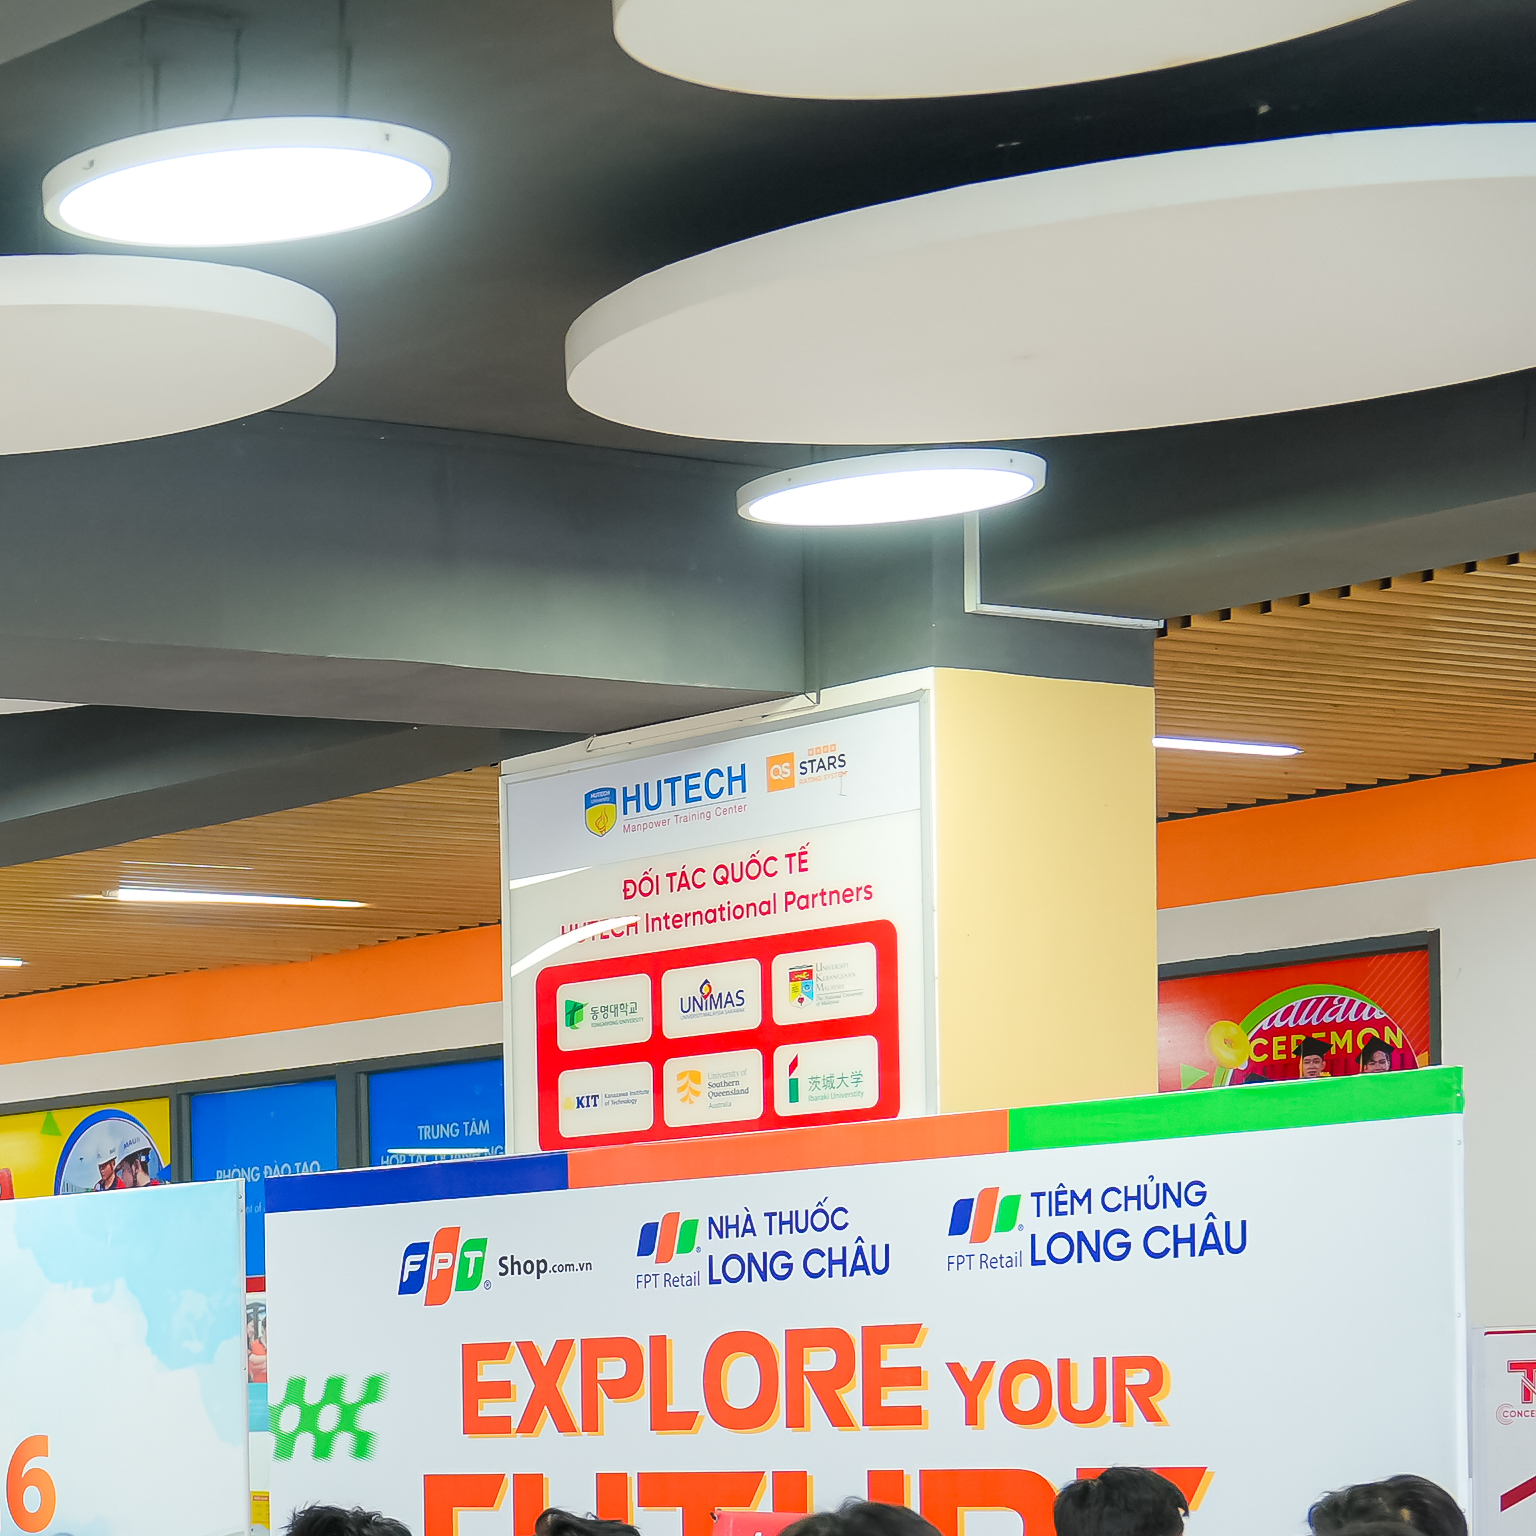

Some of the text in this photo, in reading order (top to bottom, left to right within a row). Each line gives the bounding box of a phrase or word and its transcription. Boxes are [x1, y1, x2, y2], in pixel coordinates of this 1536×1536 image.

[799, 753, 847, 776] STARS
[622, 763, 747, 816] HUTECH
[623, 803, 747, 835] Manpower Training Center
[623, 842, 811, 901] ĐỐI TÁC QUỐC TẾ
[645, 884, 874, 934] International Partners
[590, 1001, 638, 1021] 동명대학교
[708, 1068, 748, 1080] University of
[708, 1080, 740, 1089] Southern
[808, 1070, 863, 1092] 茨城大学
[576, 1094, 600, 1110] KIT
[611, 1098, 638, 1107] Technology
[708, 1087, 749, 1099] Queensland
[417, 1118, 490, 1141] TRUNG TÂM
[216, 1164, 261, 1183] PHÒNG
[263, 1160, 292, 1178] ĐÀO
[1030, 1174, 1207, 1218] TIÊM CHỦNG
[708, 1196, 849, 1240] NHÀ THUỐC
[1030, 1211, 1247, 1267] LONG CHÂU
[708, 1236, 891, 1286] LONG CHÂU
[947, 1250, 1023, 1272] FPT Retail
[636, 1270, 701, 1290] FPT Retail
[460, 1322, 1172, 1438] EXPLORE YOUR
